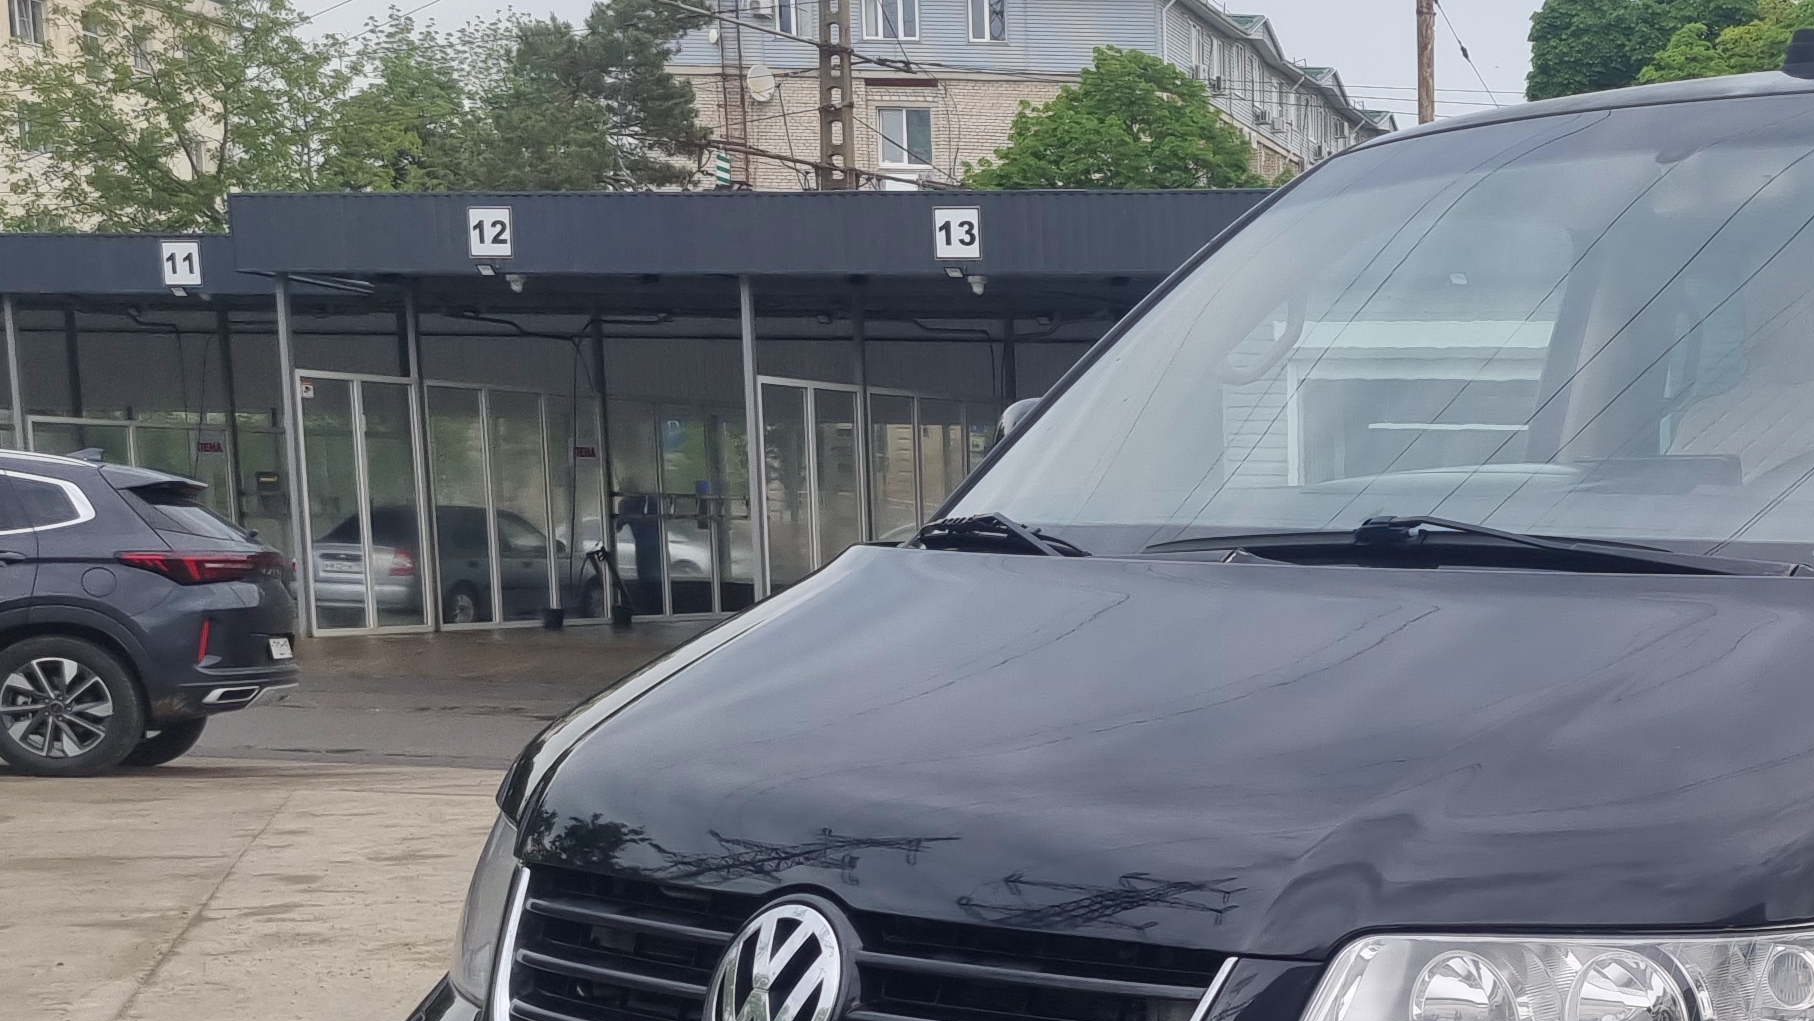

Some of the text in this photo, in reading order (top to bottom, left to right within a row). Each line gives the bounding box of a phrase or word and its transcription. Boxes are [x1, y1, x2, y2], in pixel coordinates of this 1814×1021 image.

[472, 219, 508, 245] 12
[938, 220, 977, 247] 13
[165, 252, 196, 275] 11
